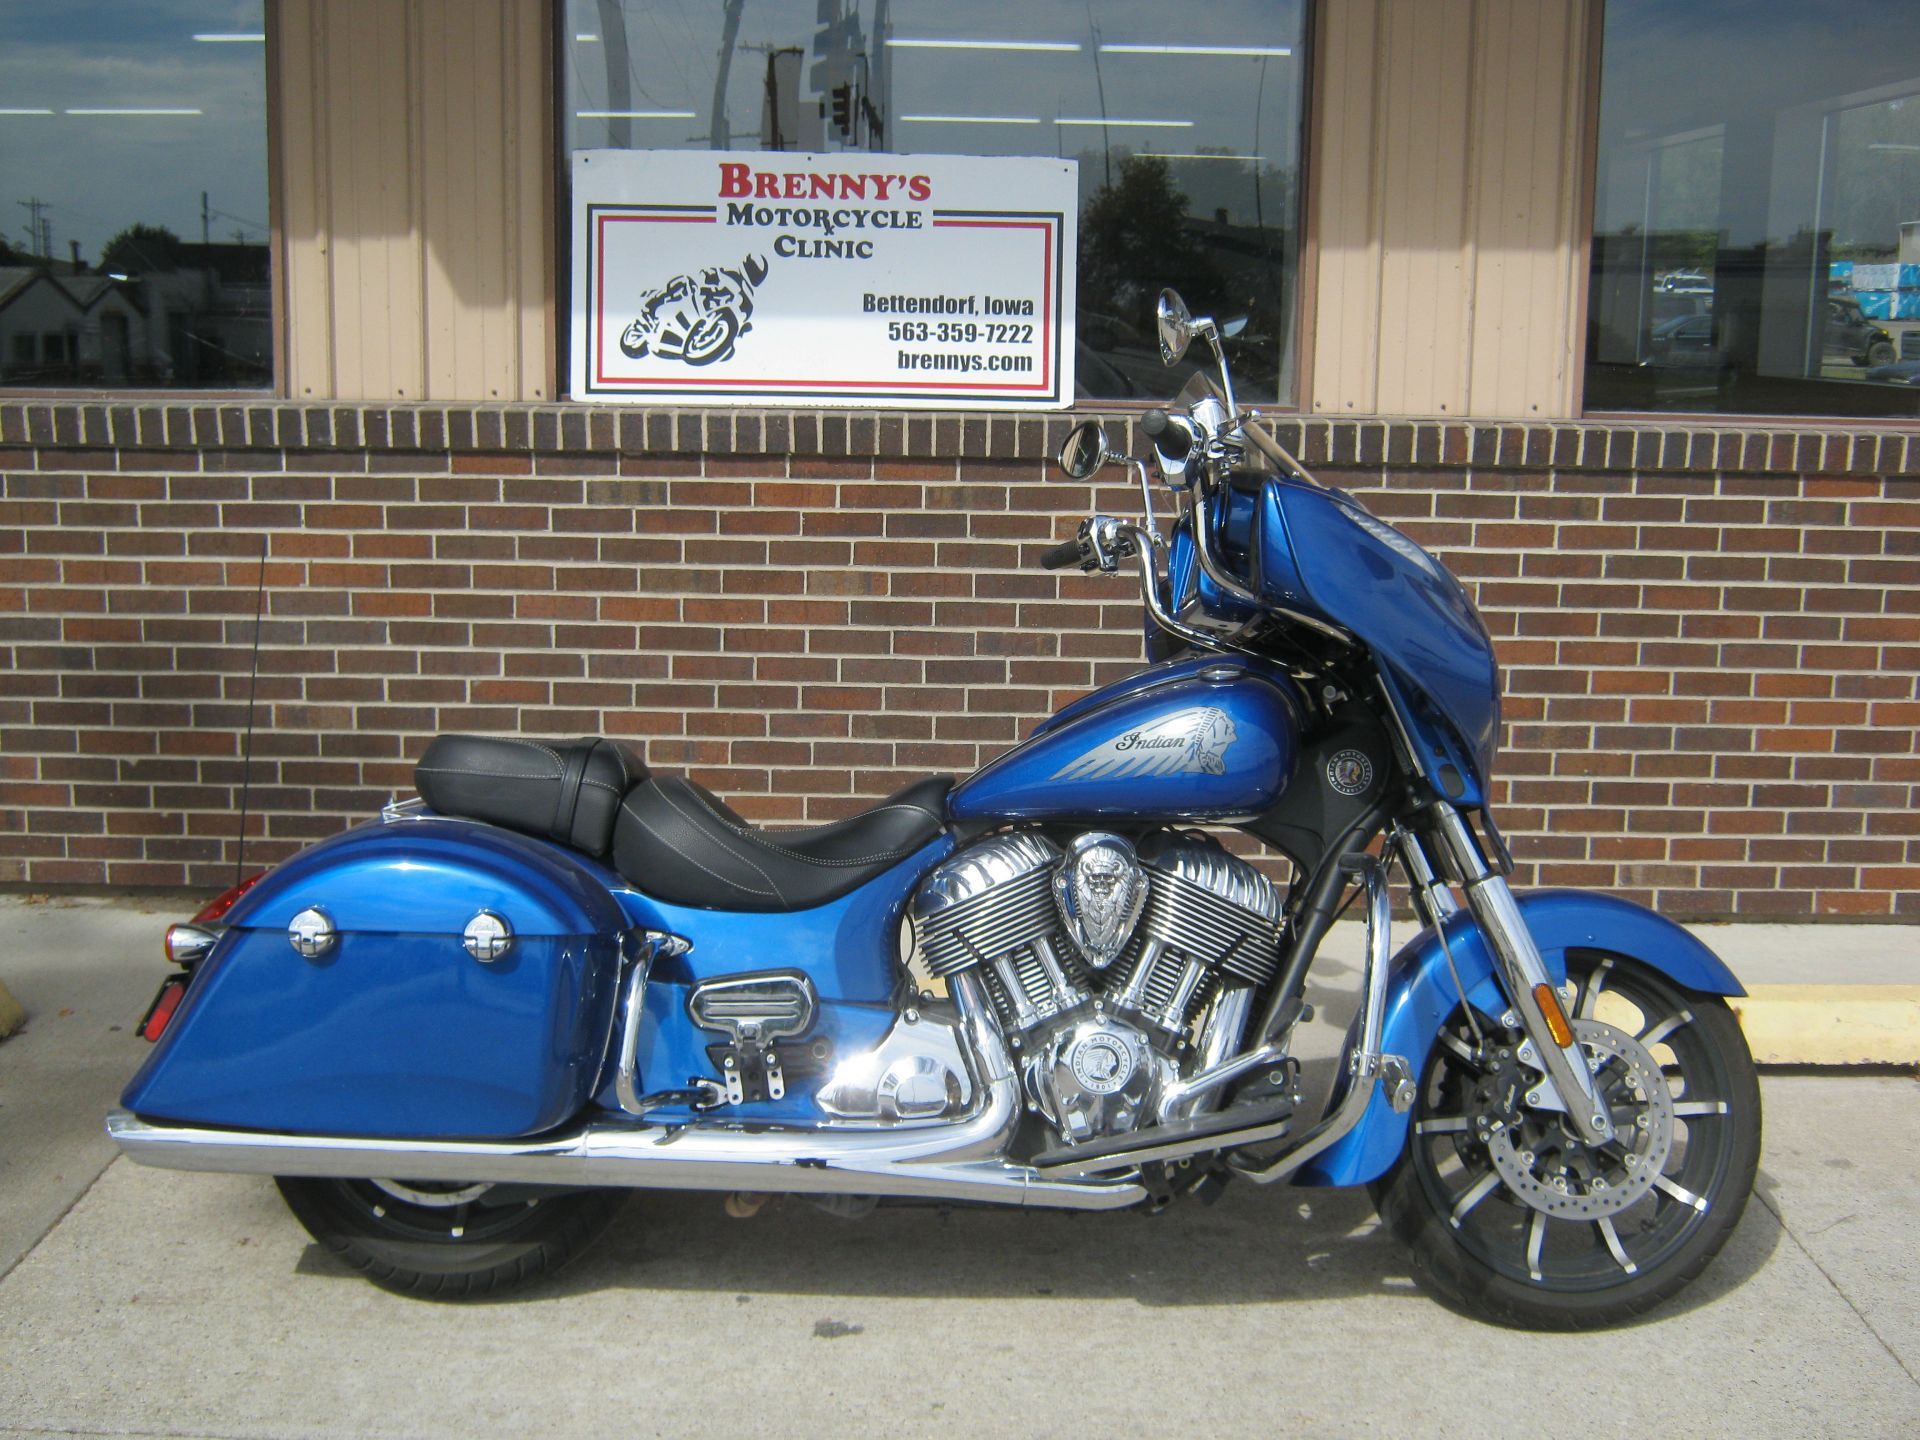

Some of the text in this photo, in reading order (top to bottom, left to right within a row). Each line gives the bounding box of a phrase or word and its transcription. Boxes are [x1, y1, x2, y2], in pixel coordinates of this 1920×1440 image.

[718, 163, 931, 201] BRENNY'S
[727, 203, 923, 234] MOTORCYCLE
[774, 235, 874, 259] CLINIC
[863, 293, 1034, 316] Bettendorf, Iowa
[888, 322, 1033, 344] 563-359-7222
[898, 350, 1033, 372] brennys.com
[1115, 731, 1186, 751] Indian
[1075, 1036, 1128, 1081] INDIAN MOTORCYCLE
